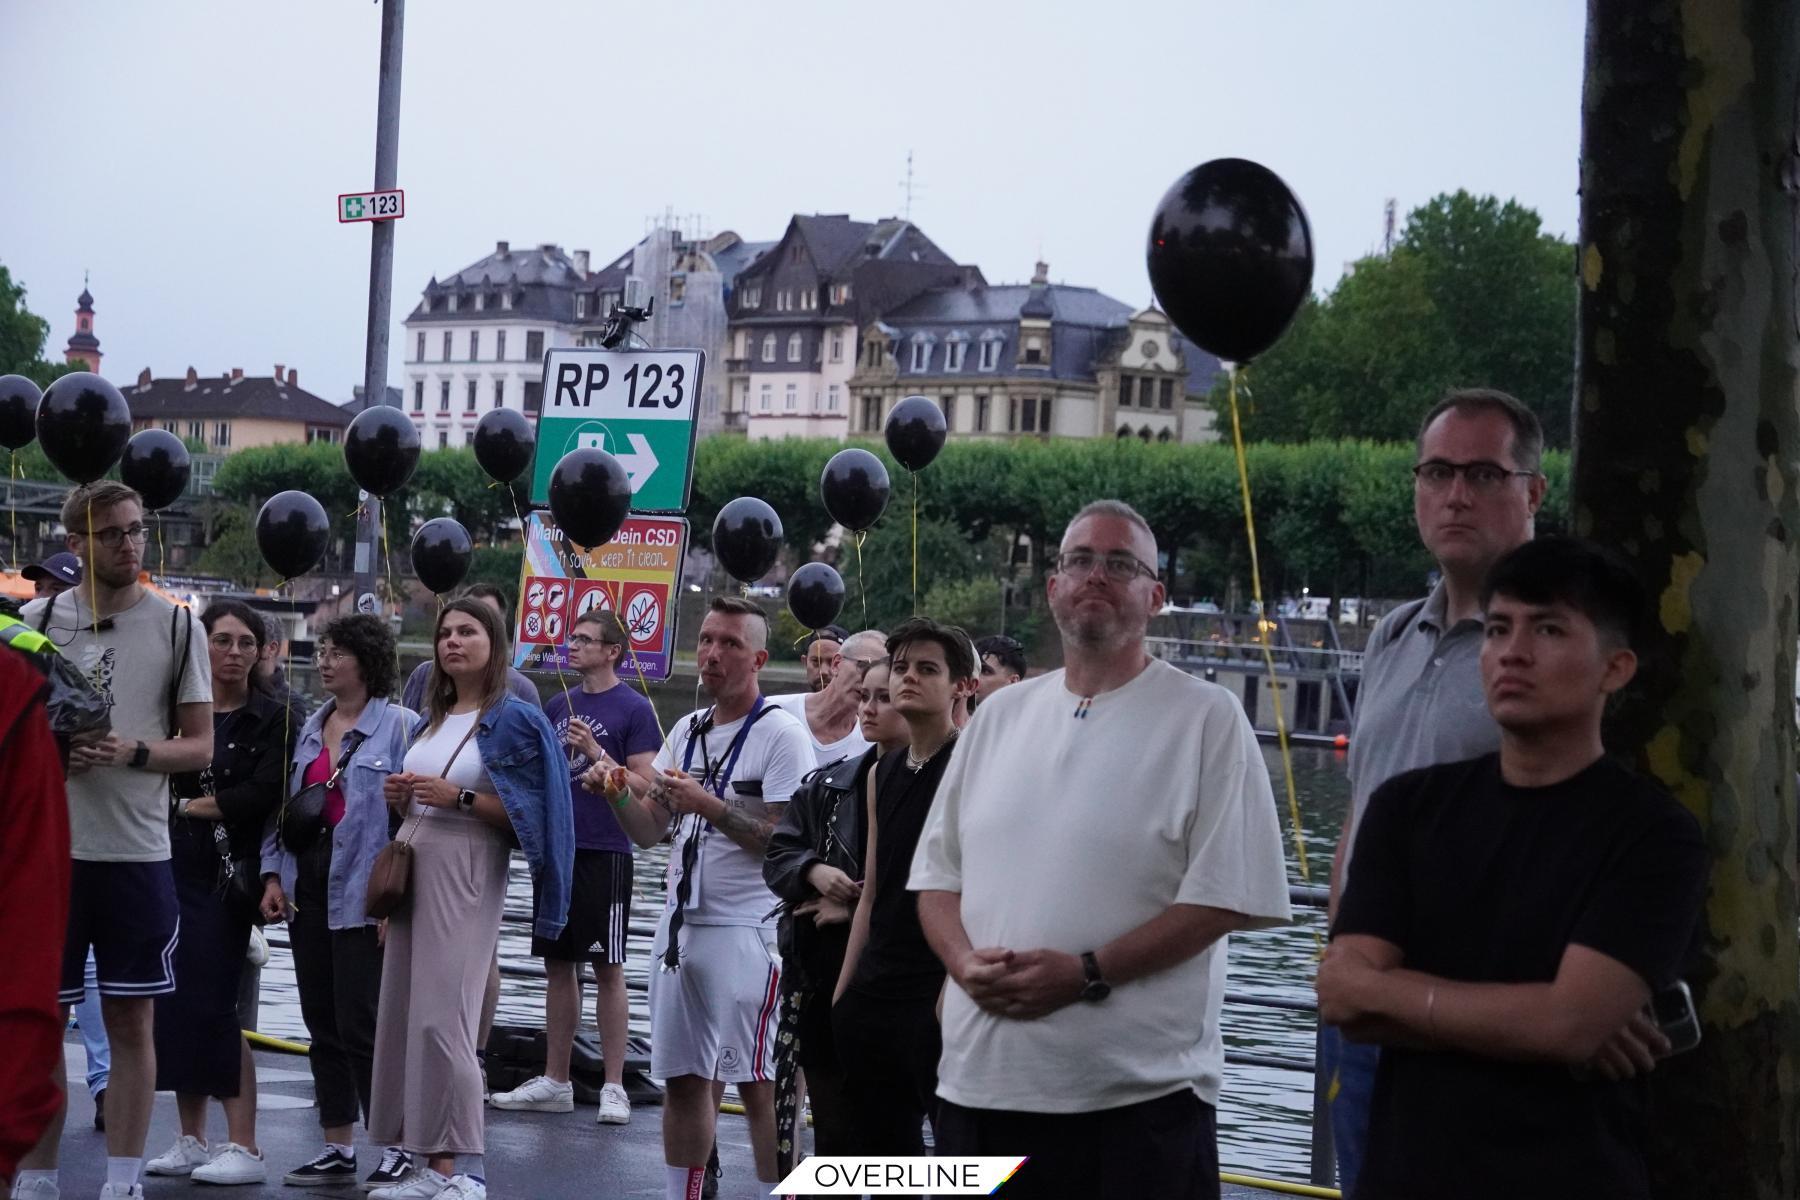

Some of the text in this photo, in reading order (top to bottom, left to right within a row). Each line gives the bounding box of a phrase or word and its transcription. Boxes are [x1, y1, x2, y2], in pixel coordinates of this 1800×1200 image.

[370, 195, 397, 215] 123
[554, 363, 685, 409] RP 123
[532, 523, 563, 542] Main
[645, 528, 677, 547] CSD
[629, 658, 658, 672] Dogen.
